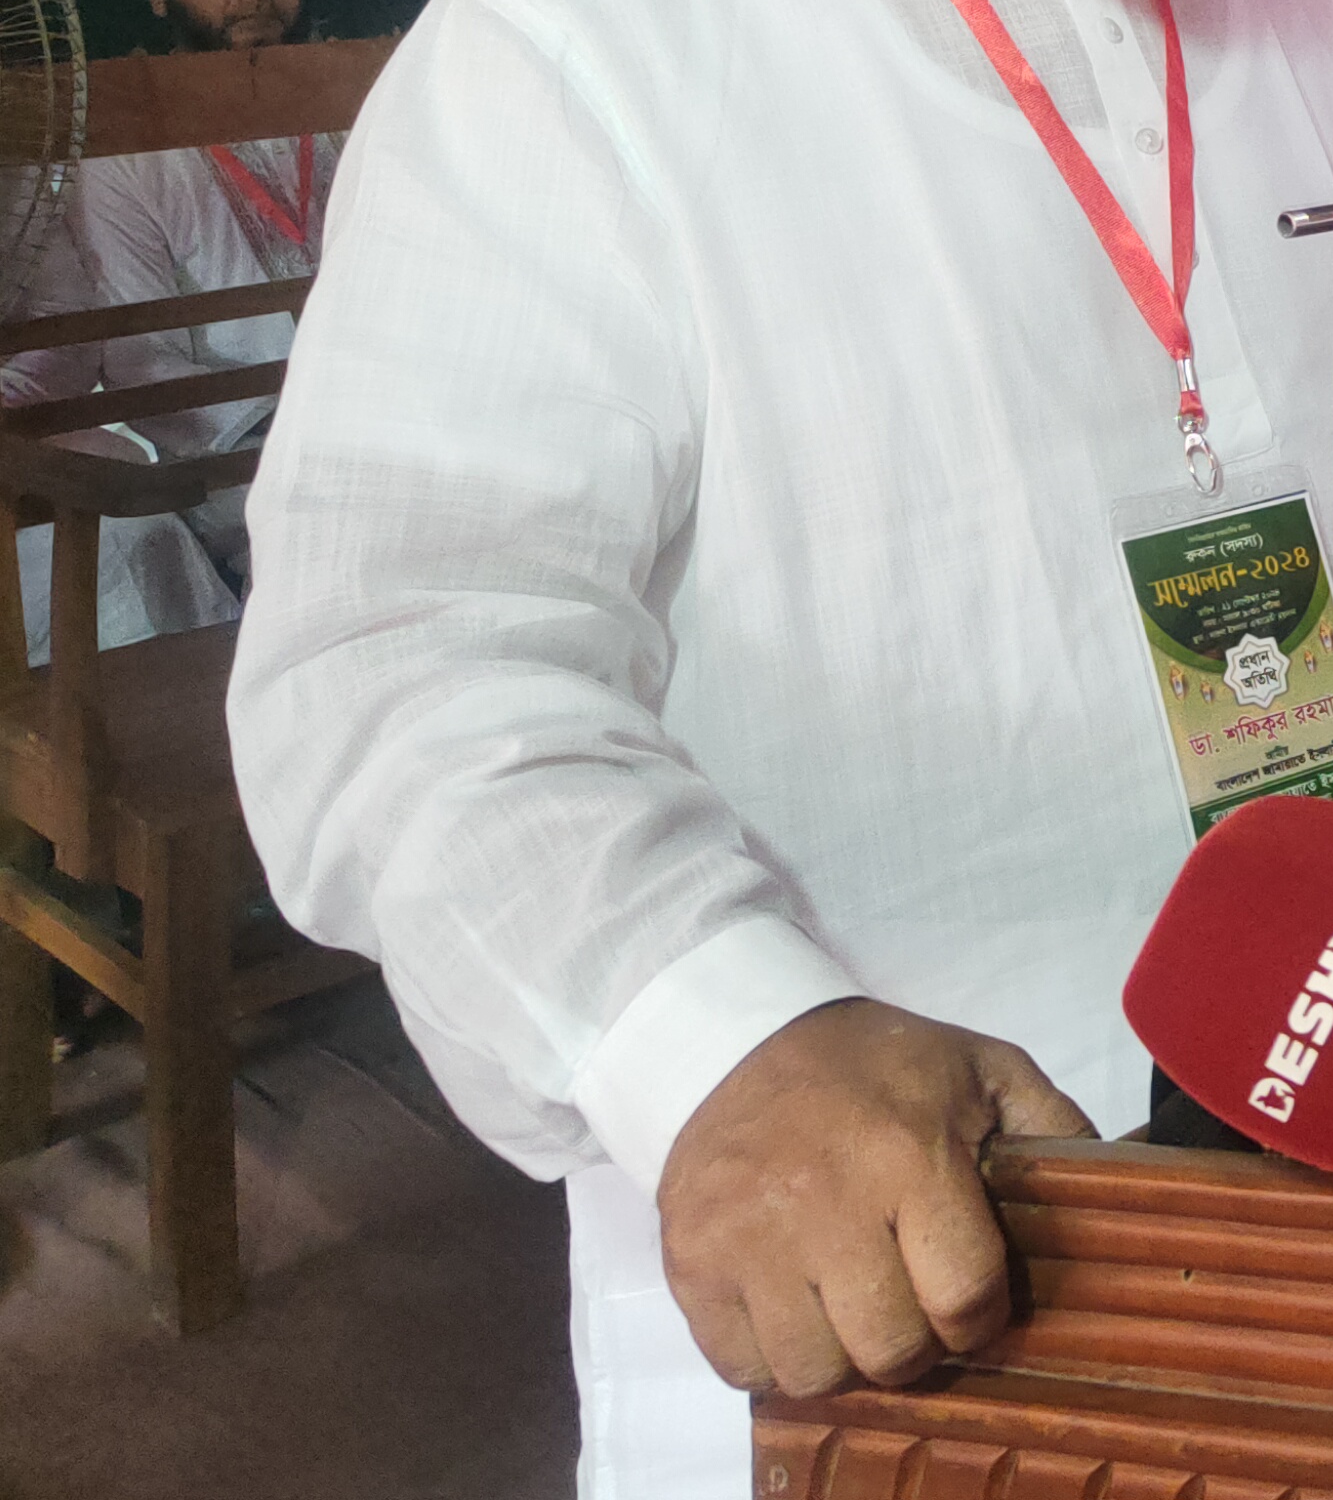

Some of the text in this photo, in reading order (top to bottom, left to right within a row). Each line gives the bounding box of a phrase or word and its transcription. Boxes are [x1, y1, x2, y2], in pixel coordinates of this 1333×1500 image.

[1239, 650, 1271, 670] প্রধান
[1241, 667, 1278, 690] অতিথি
[1189, 734, 1221, 756] ডা.
[1223, 710, 1288, 744] শফিকুর
[1215, 767, 1261, 791] বাংলাদেশ
